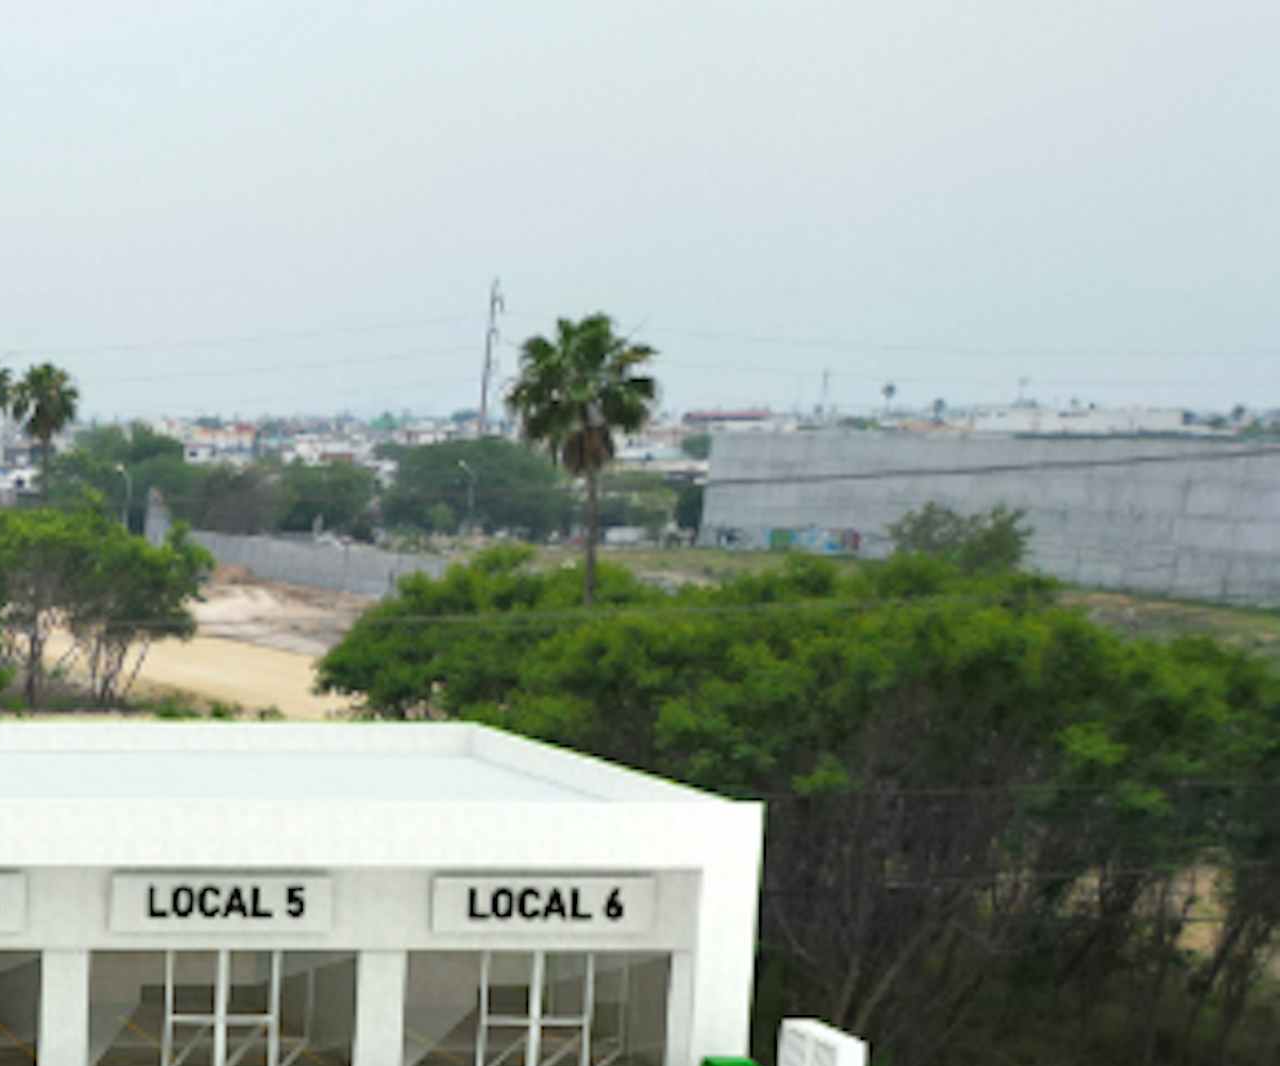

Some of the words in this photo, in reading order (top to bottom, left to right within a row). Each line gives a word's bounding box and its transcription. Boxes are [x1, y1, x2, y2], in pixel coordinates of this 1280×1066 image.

[148, 884, 273, 919] LOCAL
[285, 885, 306, 919] 5
[468, 887, 593, 921] LOCAL
[603, 887, 624, 921] 6
